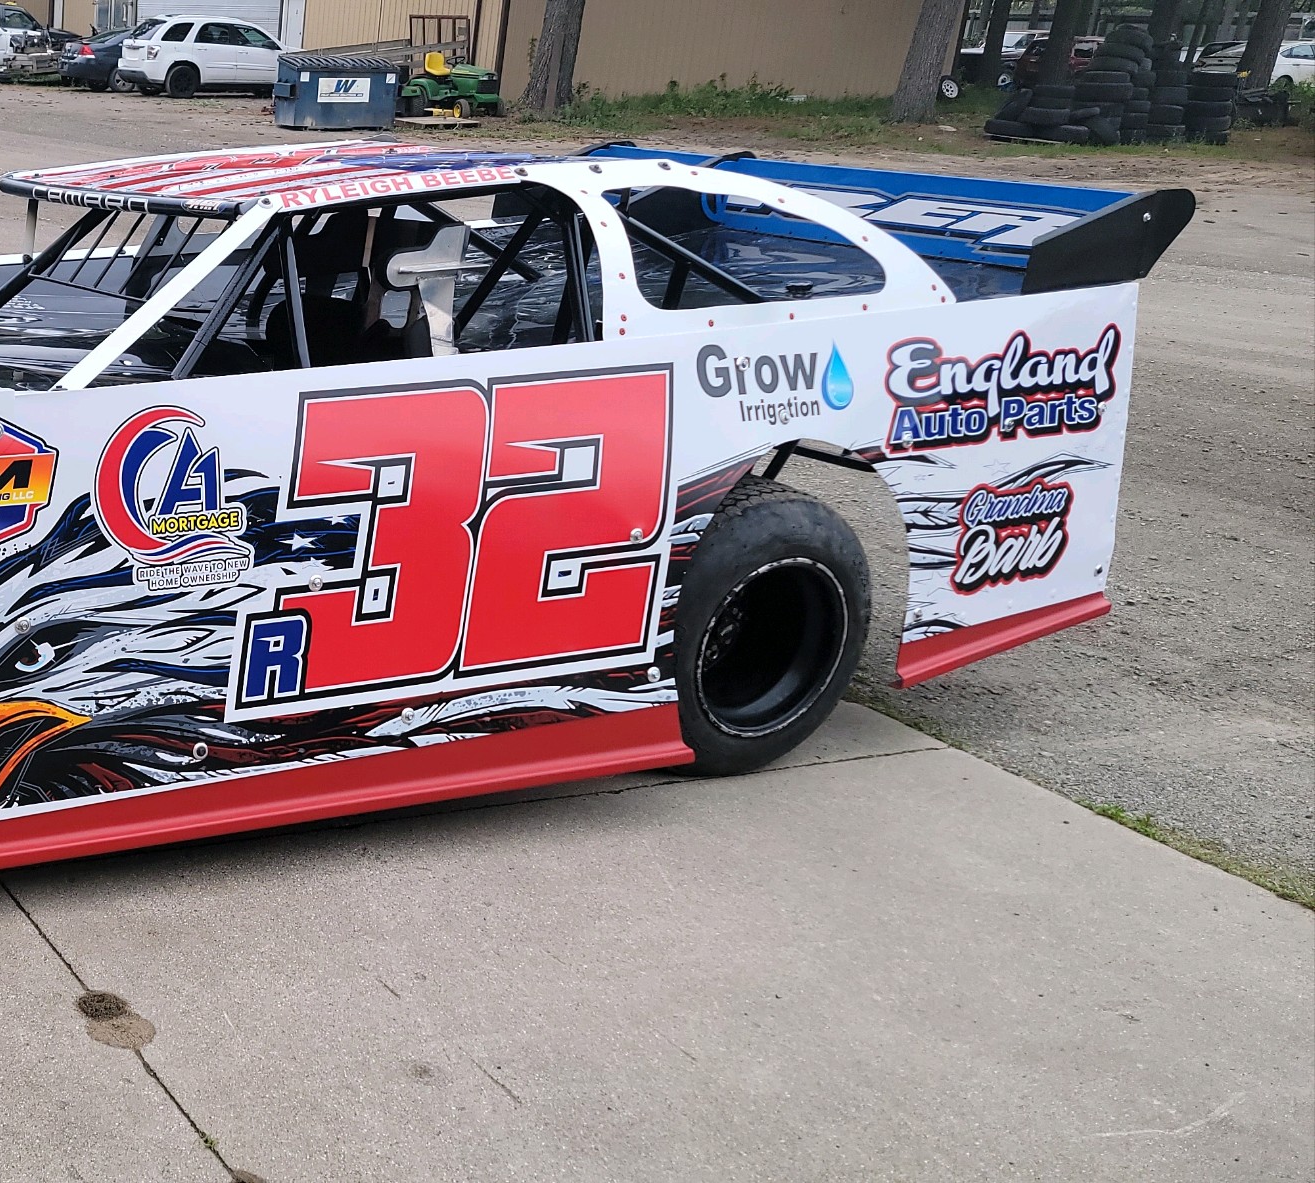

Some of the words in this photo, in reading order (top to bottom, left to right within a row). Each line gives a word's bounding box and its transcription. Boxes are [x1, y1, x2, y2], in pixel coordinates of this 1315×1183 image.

[279, 177, 414, 208] RYLEIGH
[420, 165, 516, 188] BEEBE
[696, 344, 819, 398] Grow
[888, 328, 1116, 417] England
[739, 398, 820, 427] Irrigation
[891, 403, 986, 448] Auto
[1000, 394, 1098, 432] Parts
[12, 490, 34, 500] LLC
[964, 484, 1068, 529] Grandma
[151, 512, 239, 534] MORTGAGE
[278, 364, 672, 692] 32
[139, 568, 160, 578] RIDE
[163, 566, 180, 576] THE
[183, 563, 209, 574] WAVE
[211, 562, 224, 571] TO
[227, 560, 247, 569] NEW
[955, 517, 1064, 586] Barb
[151, 577, 179, 588] HOME
[182, 571, 237, 585] OWNERSHIP
[242, 617, 307, 702] R
